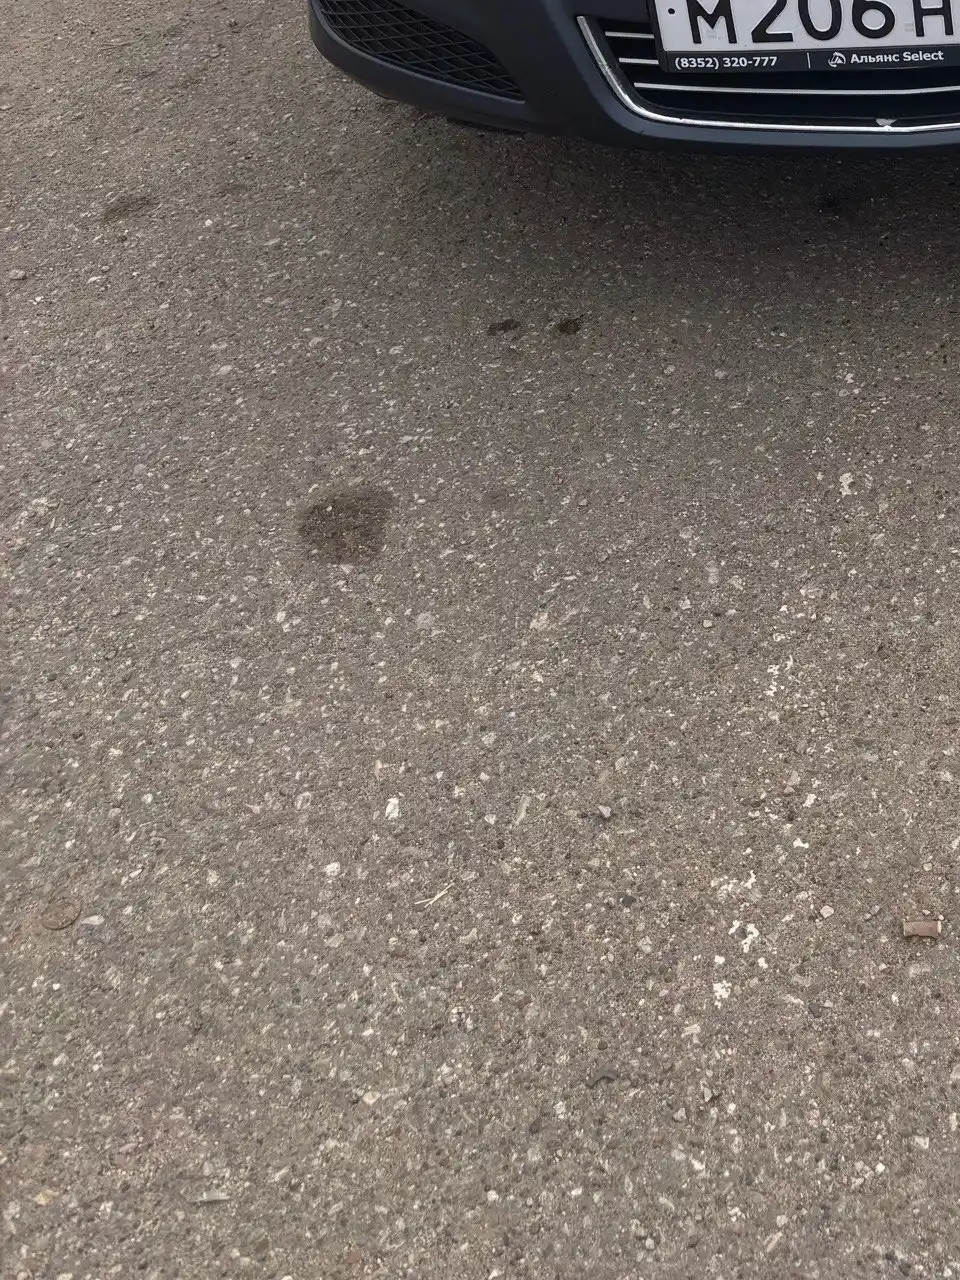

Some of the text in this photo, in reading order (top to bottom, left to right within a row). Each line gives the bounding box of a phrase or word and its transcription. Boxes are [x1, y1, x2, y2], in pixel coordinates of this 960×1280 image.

[674, 56, 778, 70] (8352) 320-777
[850, 49, 945, 64] Альянс Select
